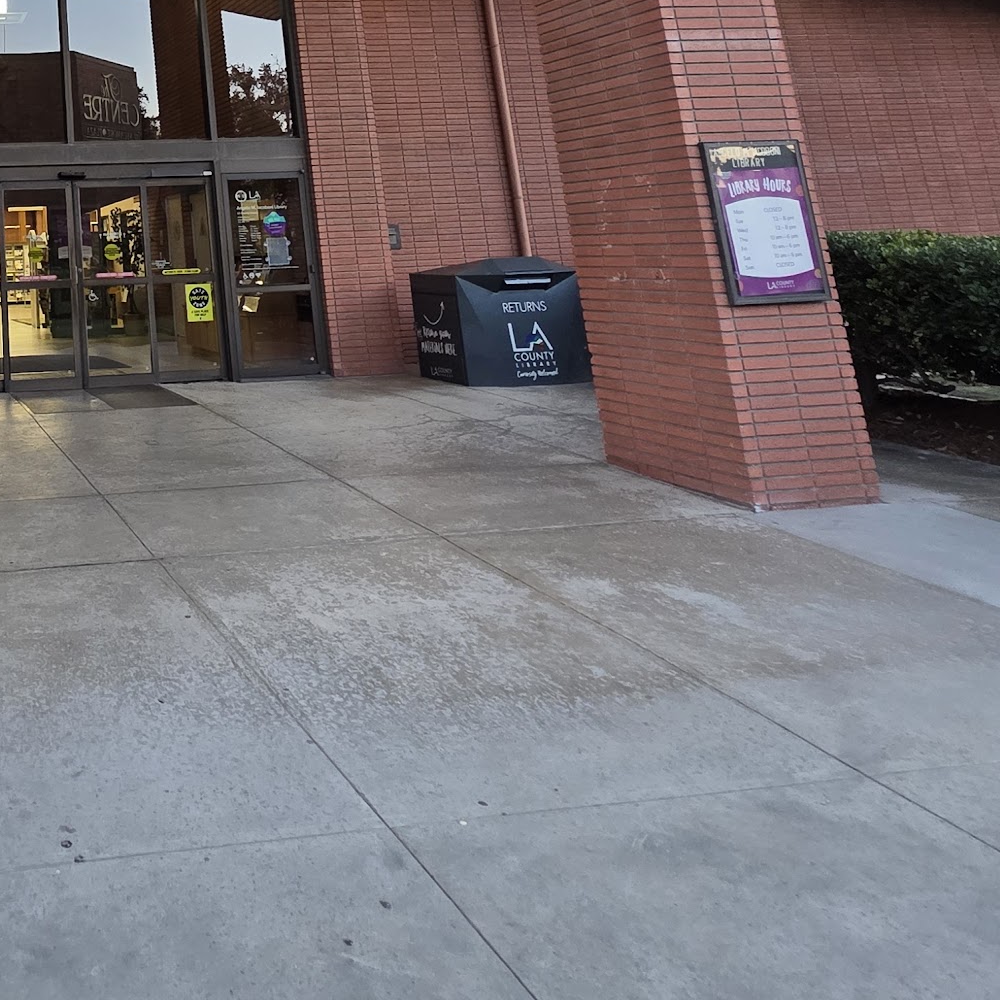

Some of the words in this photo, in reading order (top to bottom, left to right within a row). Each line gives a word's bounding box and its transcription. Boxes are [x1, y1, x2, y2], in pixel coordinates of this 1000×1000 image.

[732, 157, 765, 168] LIBRARY
[727, 178, 760, 198] LIBRARY
[763, 177, 791, 193] HOURS
[502, 300, 548, 313] RETURNS
[507, 321, 554, 352] LA
[513, 351, 554, 362] COUNTY
